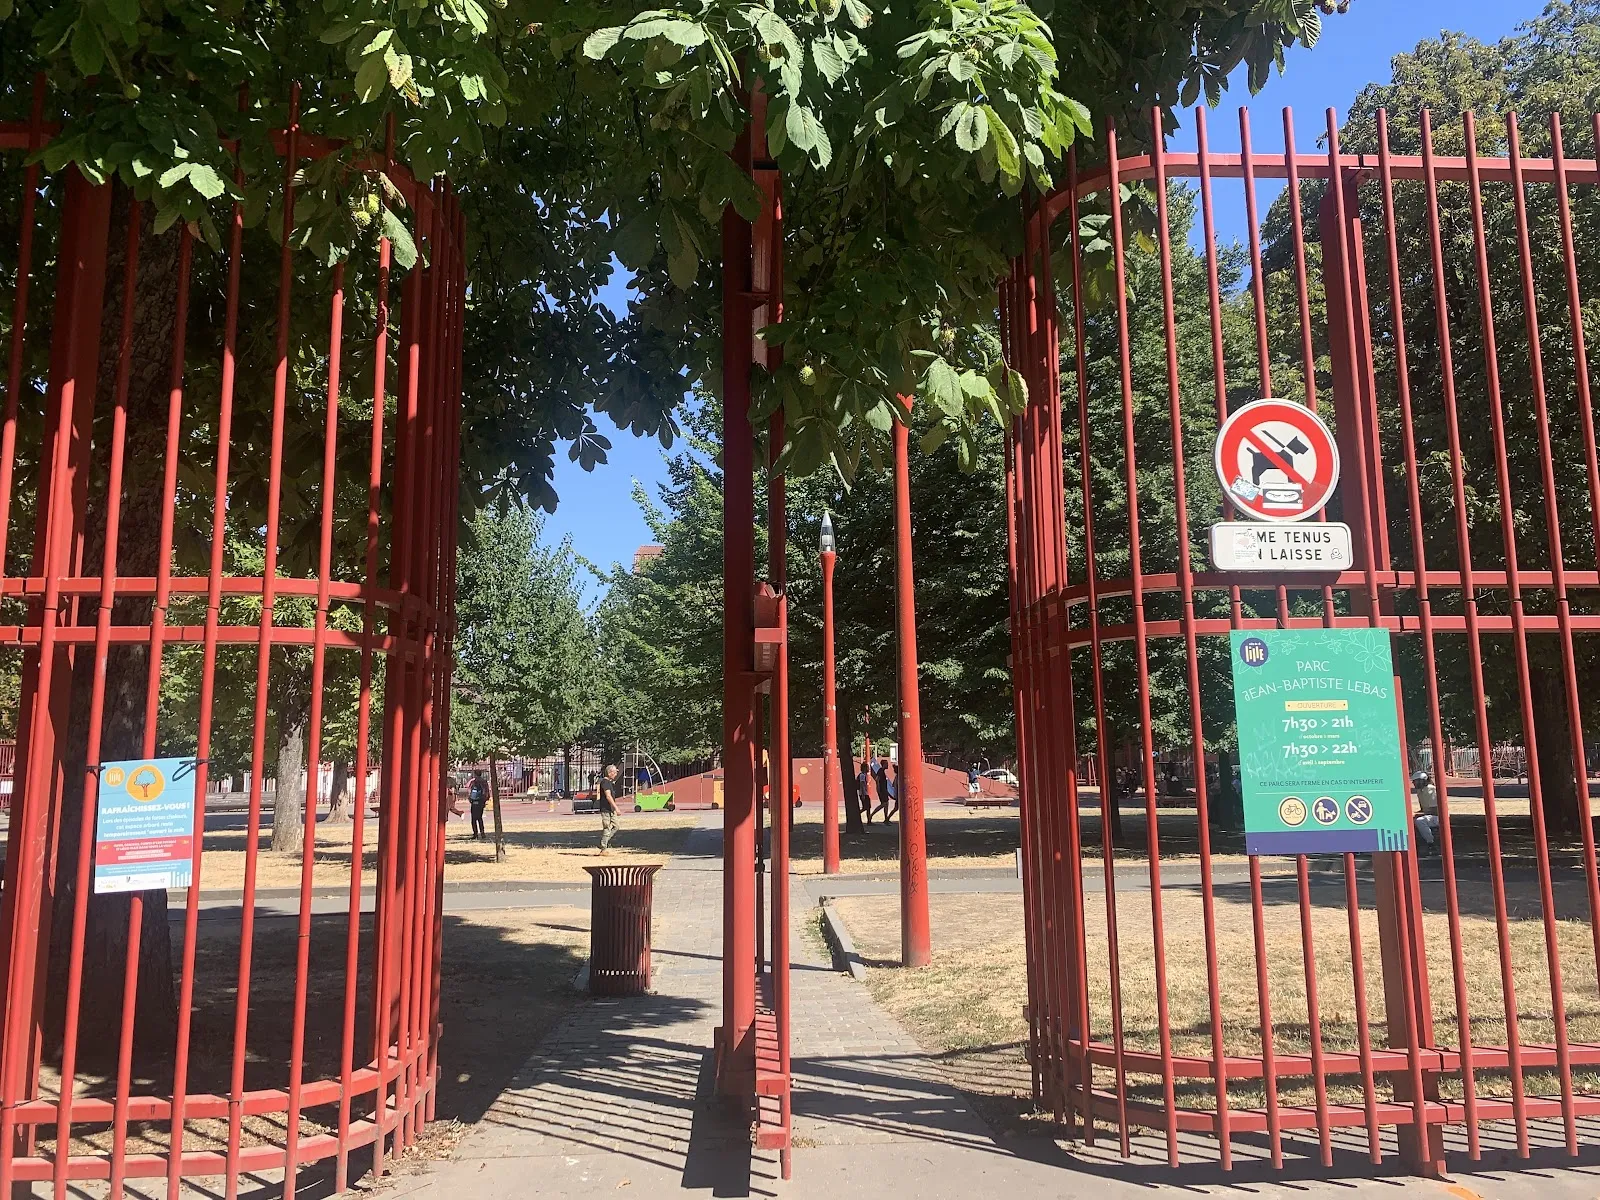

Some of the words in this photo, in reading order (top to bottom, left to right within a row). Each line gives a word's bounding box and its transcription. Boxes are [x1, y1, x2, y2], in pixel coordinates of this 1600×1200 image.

[1257, 531, 1276, 543] ME
[1284, 531, 1331, 543] TENUS
[1270, 548, 1322, 560] LAISSE
[1295, 660, 1330, 672] PARC
[1241, 677, 1344, 702] JEAN-BAPTISTE
[1347, 679, 1388, 699] LEBAS
[1297, 701, 1337, 709] OUVERTURE
[1281, 716, 1318, 732] 7h30
[1331, 714, 1354, 728] 21h
[1282, 742, 1319, 758] 7h30
[1331, 740, 1358, 754] 22h
